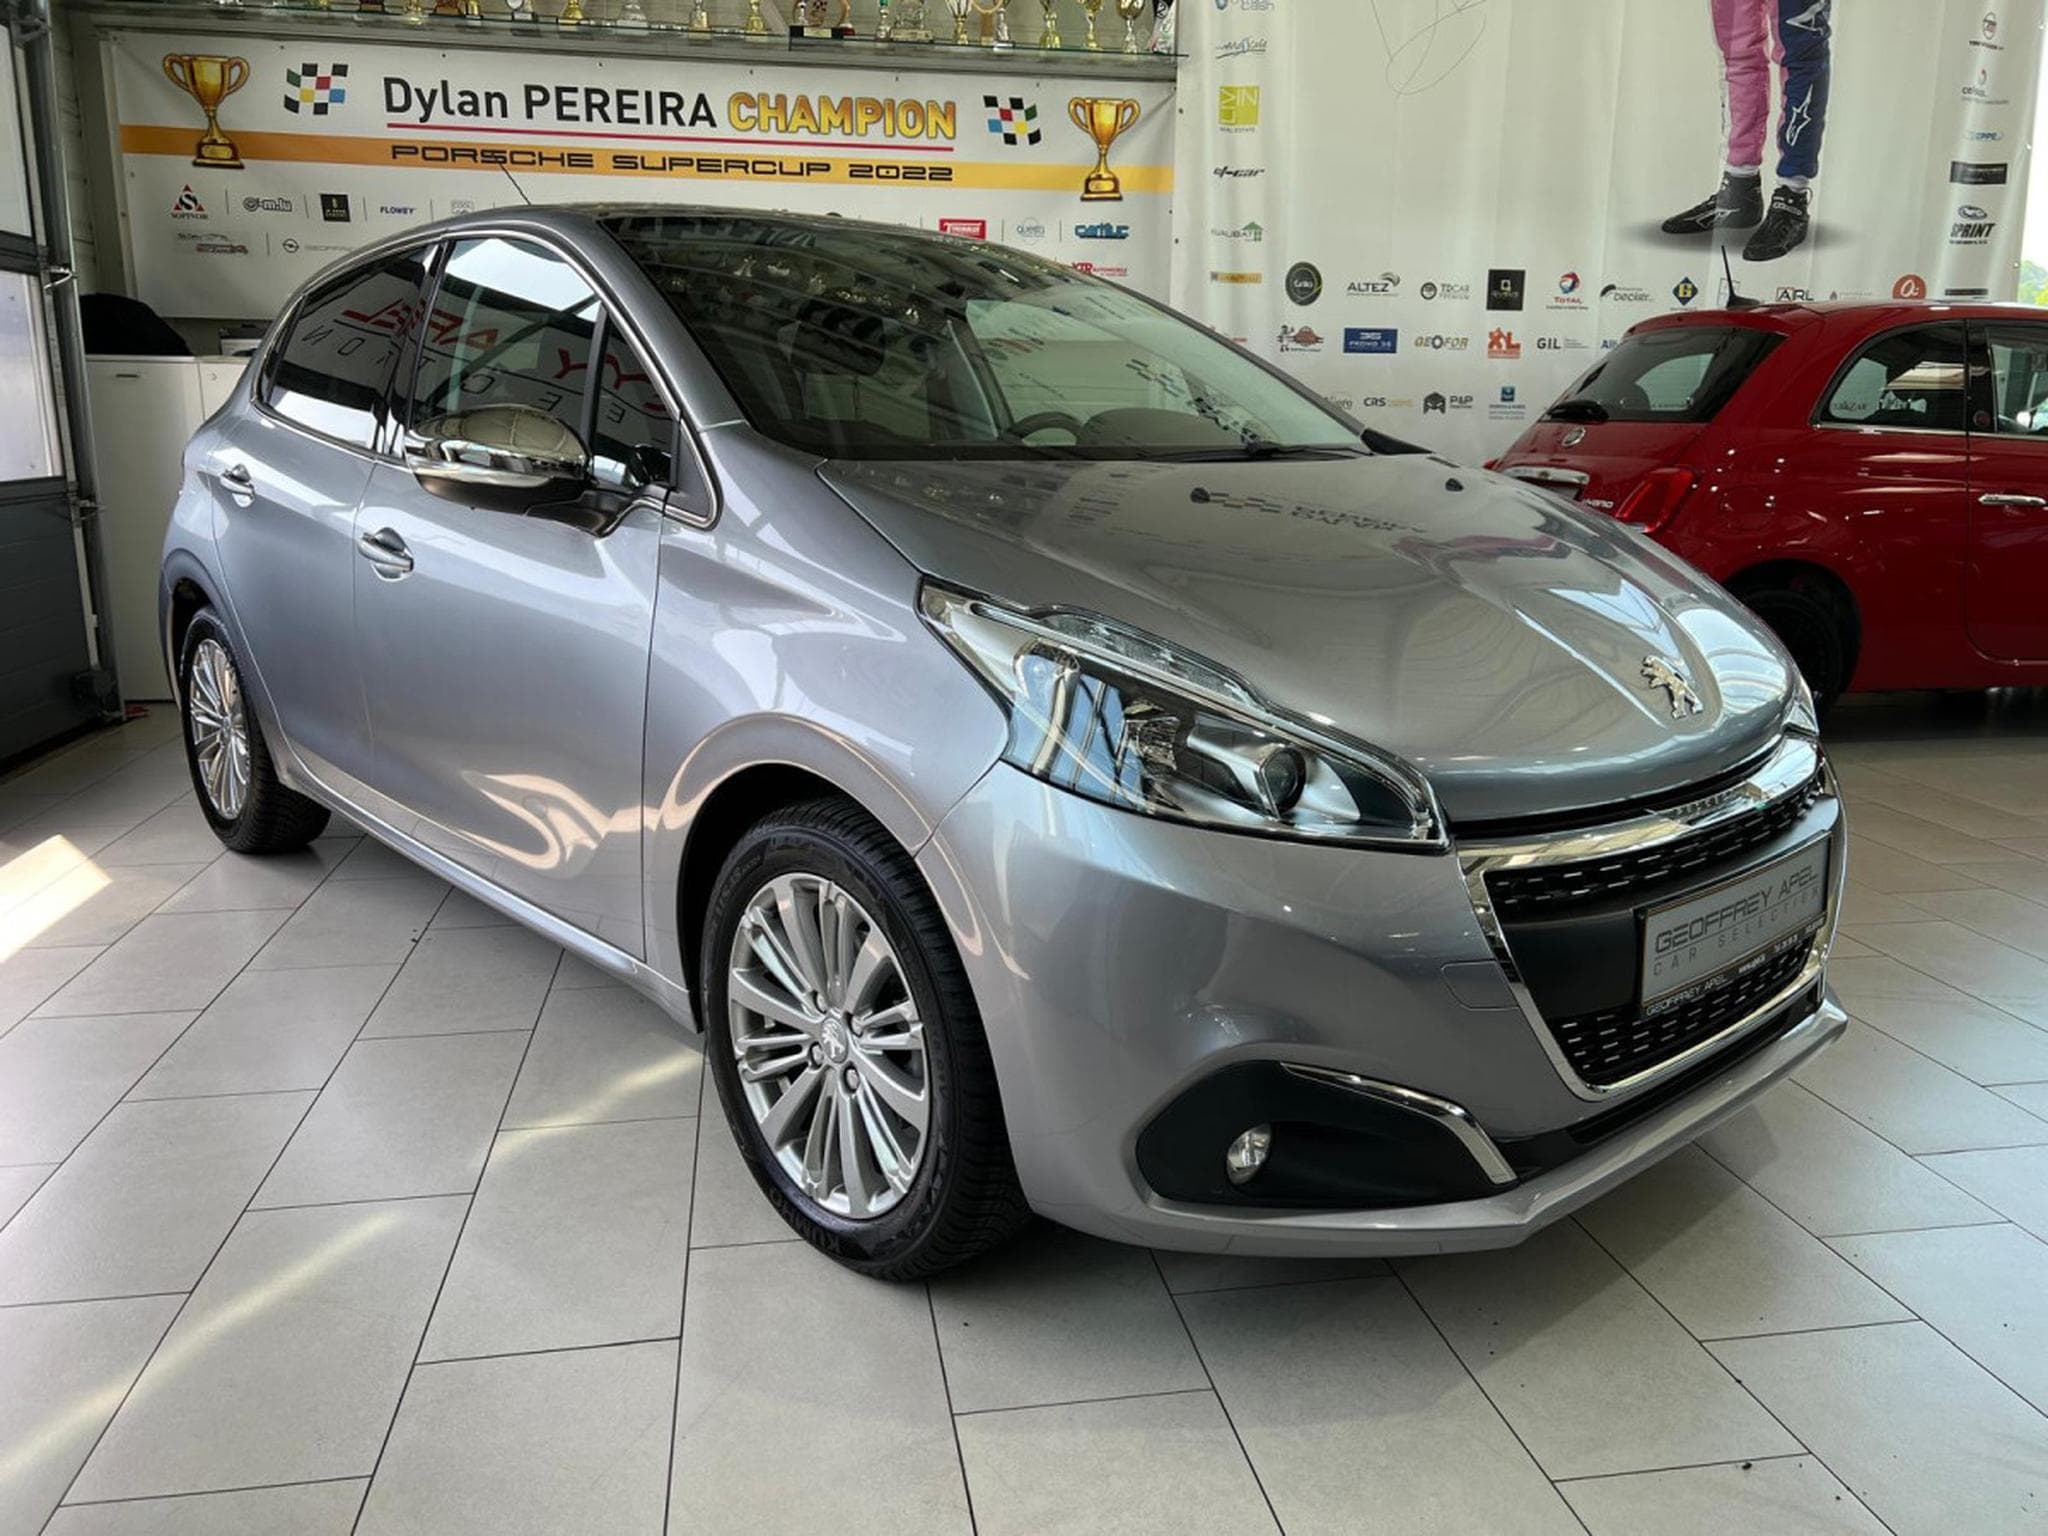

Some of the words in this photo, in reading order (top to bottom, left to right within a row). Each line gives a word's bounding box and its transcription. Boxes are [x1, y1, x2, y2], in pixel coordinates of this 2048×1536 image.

[384, 77, 508, 125] Dylan
[524, 84, 717, 129] PEREIRA
[727, 91, 958, 141] CHAMPION
[391, 145, 594, 169] PORSCHE
[612, 155, 831, 178] SUPERCUP
[849, 163, 953, 182] 2022
[1950, 222, 1997, 239] SPRINT
[1346, 281, 1390, 293] ALTEZ
[1554, 296, 1582, 304] TOTAL
[1414, 335, 1469, 350] GEOFOR
[1536, 337, 1562, 350] GIL
[1655, 885, 1773, 954] GEOFFREY
[1779, 865, 1819, 899] APEL
[1653, 947, 1698, 977] CAR
